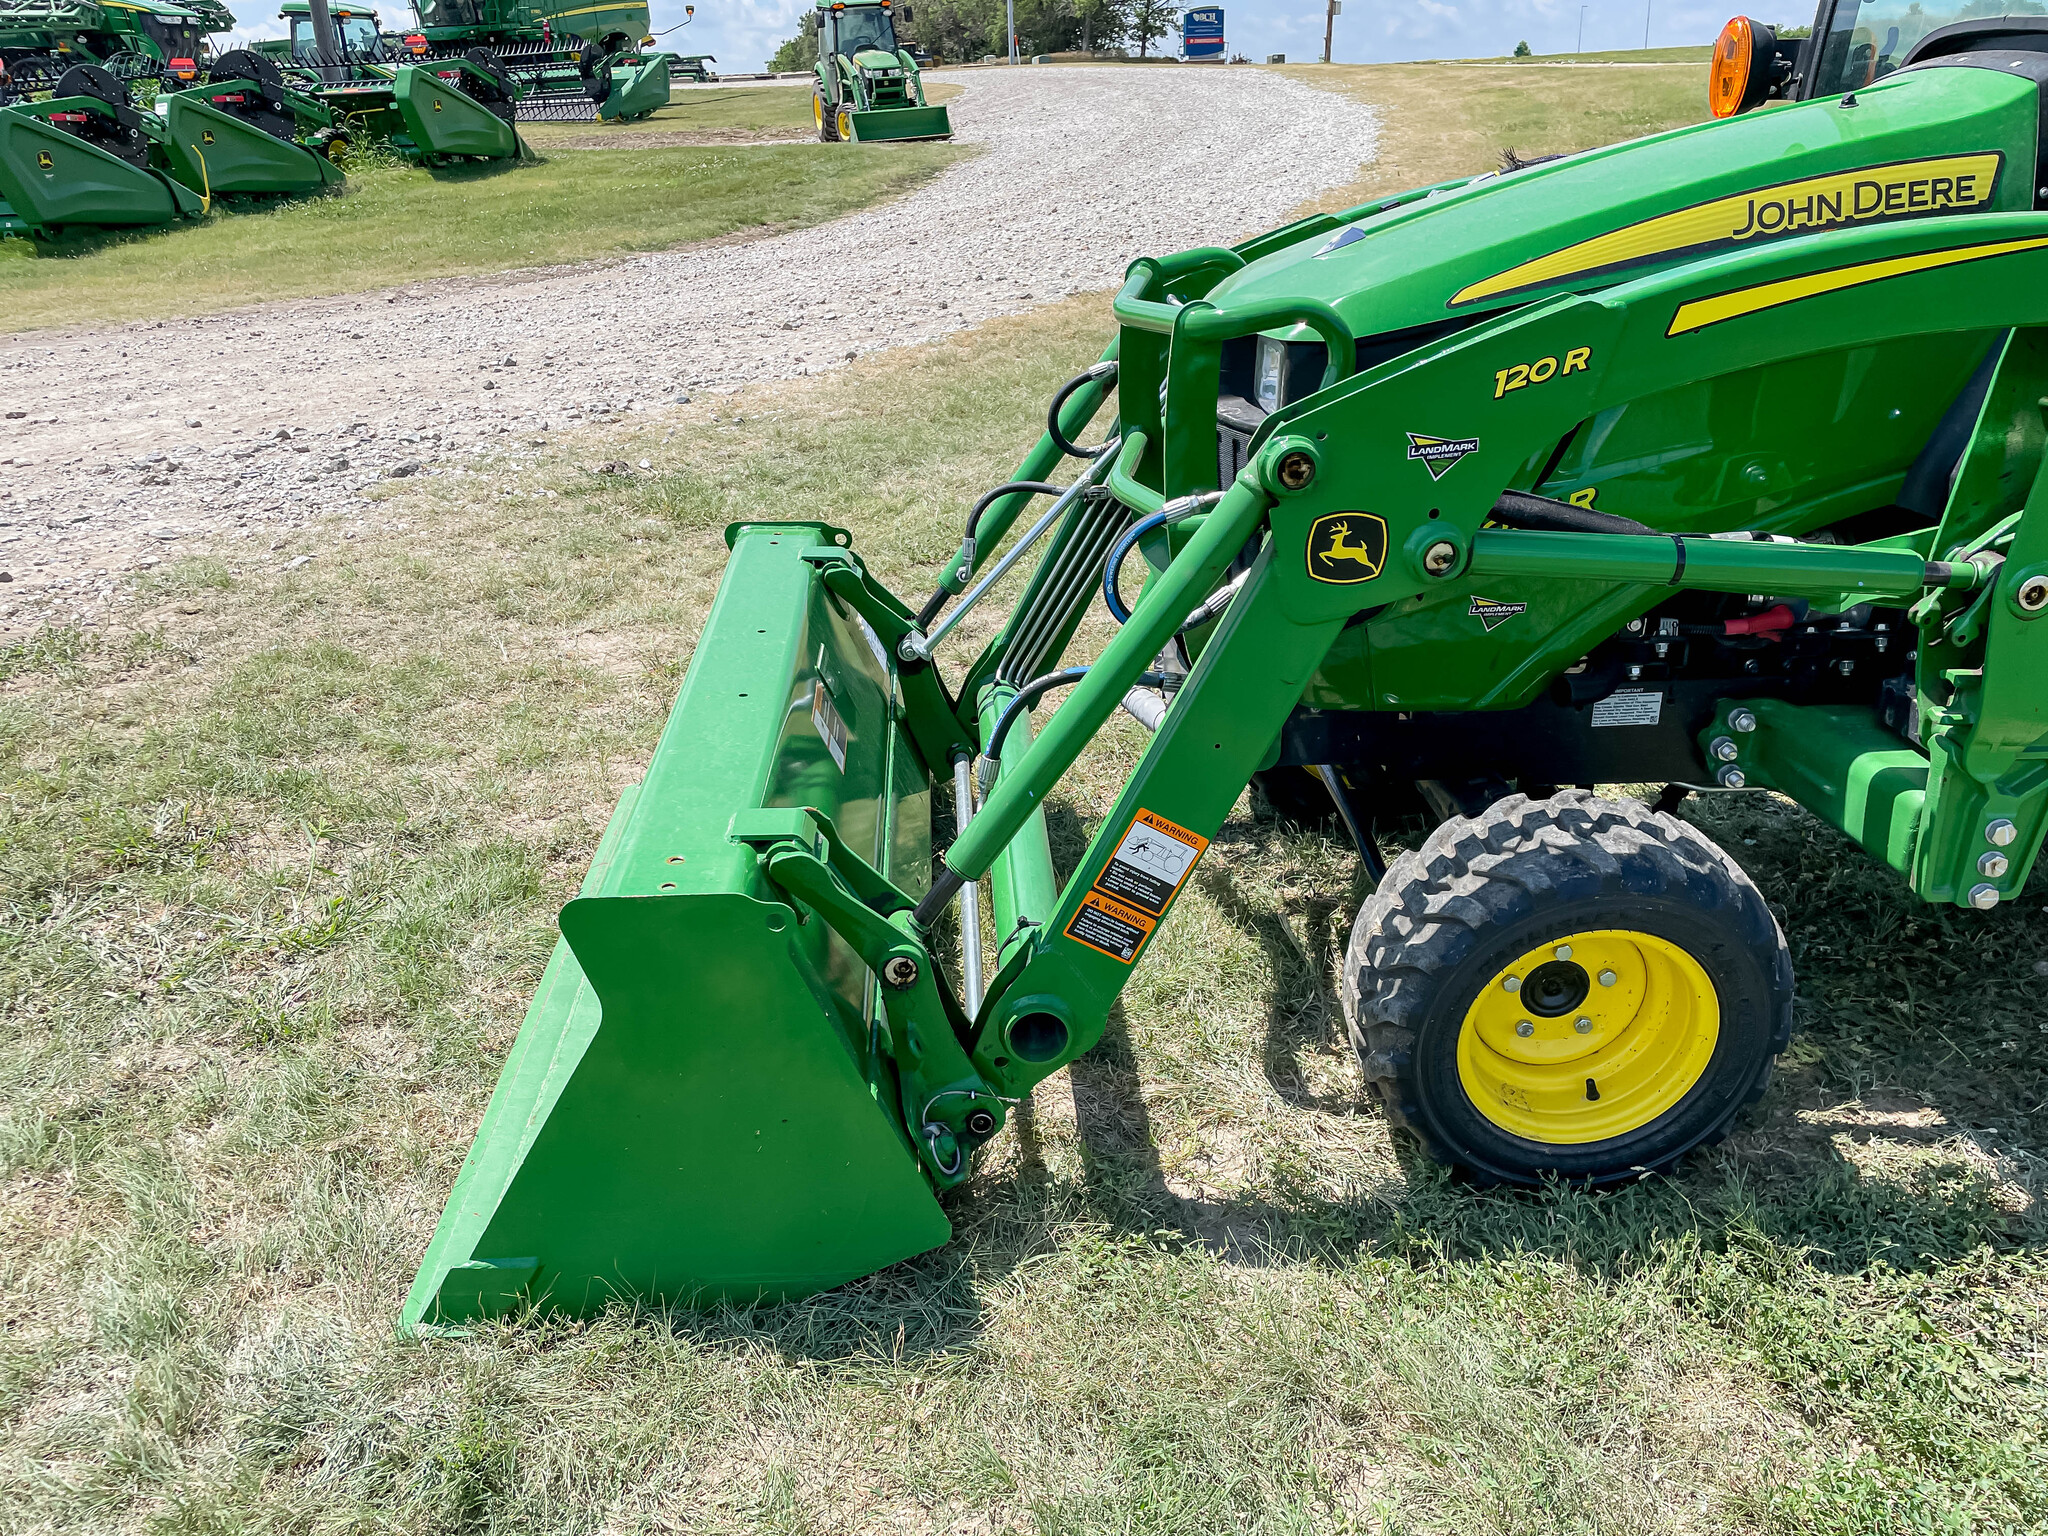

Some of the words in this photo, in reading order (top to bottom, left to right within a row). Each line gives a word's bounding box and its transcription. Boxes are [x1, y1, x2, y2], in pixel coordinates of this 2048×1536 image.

[1732, 191, 1843, 236] JOHN
[1853, 175, 1977, 216] DEERE
[1411, 442, 1476, 456] LANDMARK
[1471, 605, 1524, 613] LANDMARK
[1155, 819, 1199, 845] WARNING
[1104, 902, 1147, 928] WARNING
